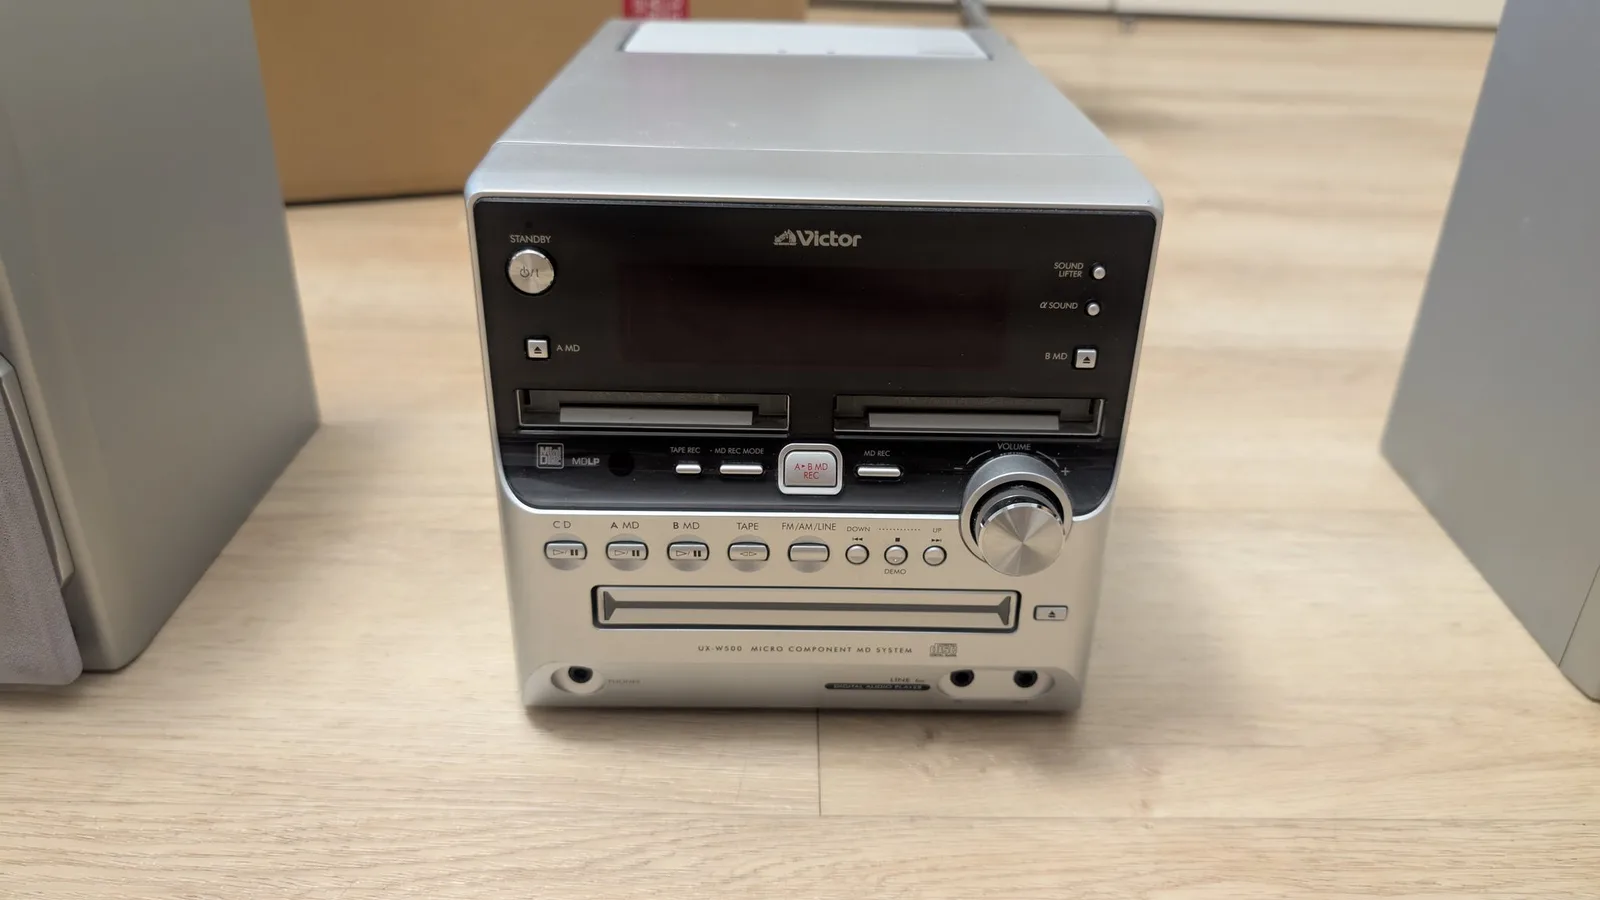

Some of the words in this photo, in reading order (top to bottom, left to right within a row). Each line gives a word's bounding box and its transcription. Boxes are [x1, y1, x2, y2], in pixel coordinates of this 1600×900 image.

[509, 234, 552, 244] STANDBY
[796, 229, 862, 247] Victor
[1053, 261, 1084, 270] SOUND
[1058, 270, 1083, 278] LIFTER
[1048, 301, 1079, 310] SOUND
[556, 344, 564, 352] A
[564, 344, 581, 352] MD
[1044, 352, 1051, 360] B
[1052, 352, 1068, 360] MD
[670, 446, 686, 454] TAPE
[687, 446, 701, 454] REC
[727, 447, 741, 455] REC
[742, 447, 765, 455] MODE
[997, 442, 1032, 451] VOLUME
[571, 457, 600, 466] MDLP
[794, 463, 801, 471] A
[807, 463, 813, 471] B
[814, 463, 829, 471] MD
[803, 471, 820, 480] REC
[610, 521, 619, 529] A
[622, 521, 640, 530] MD
[672, 521, 680, 530] B
[682, 521, 700, 530] MD
[736, 522, 759, 531] TAPE
[846, 525, 871, 533] DOWN
[884, 568, 907, 576] DEMO
[750, 645, 784, 653] MICRO
[788, 645, 852, 654] COMPONENT
[856, 646, 872, 654] MD
[876, 646, 913, 654] SYSTEM
